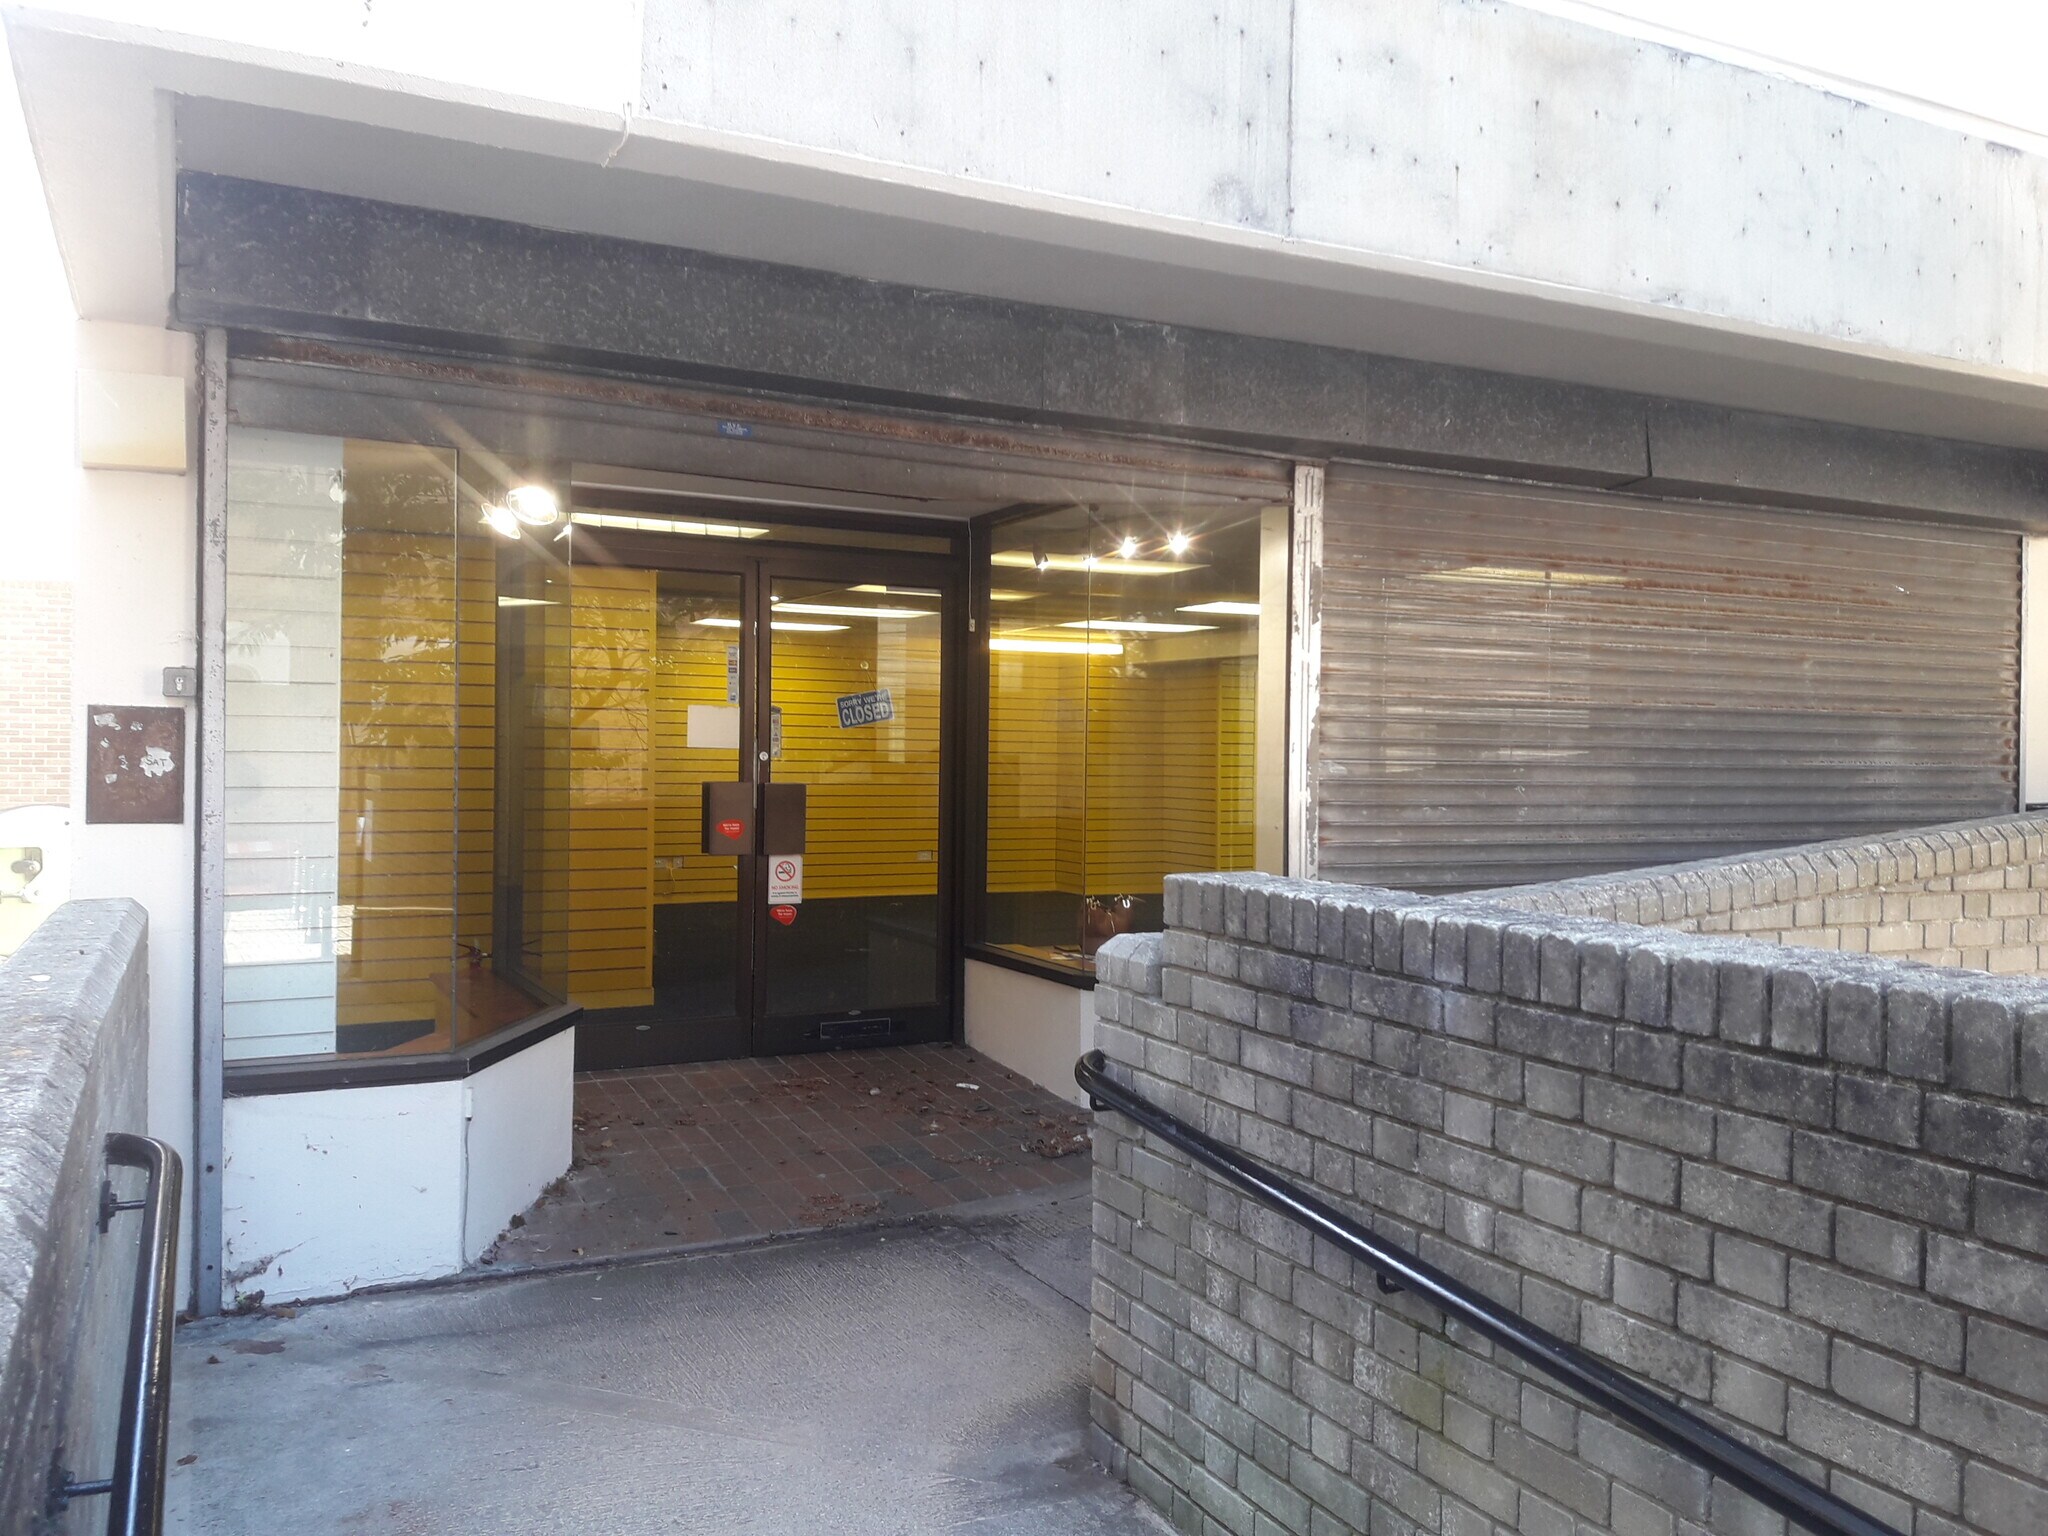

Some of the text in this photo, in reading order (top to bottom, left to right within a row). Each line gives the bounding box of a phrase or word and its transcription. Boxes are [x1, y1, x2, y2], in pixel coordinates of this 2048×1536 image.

[840, 697, 862, 708] SORRY
[842, 702, 889, 725] CLOSED
[144, 754, 167, 767] SAT
